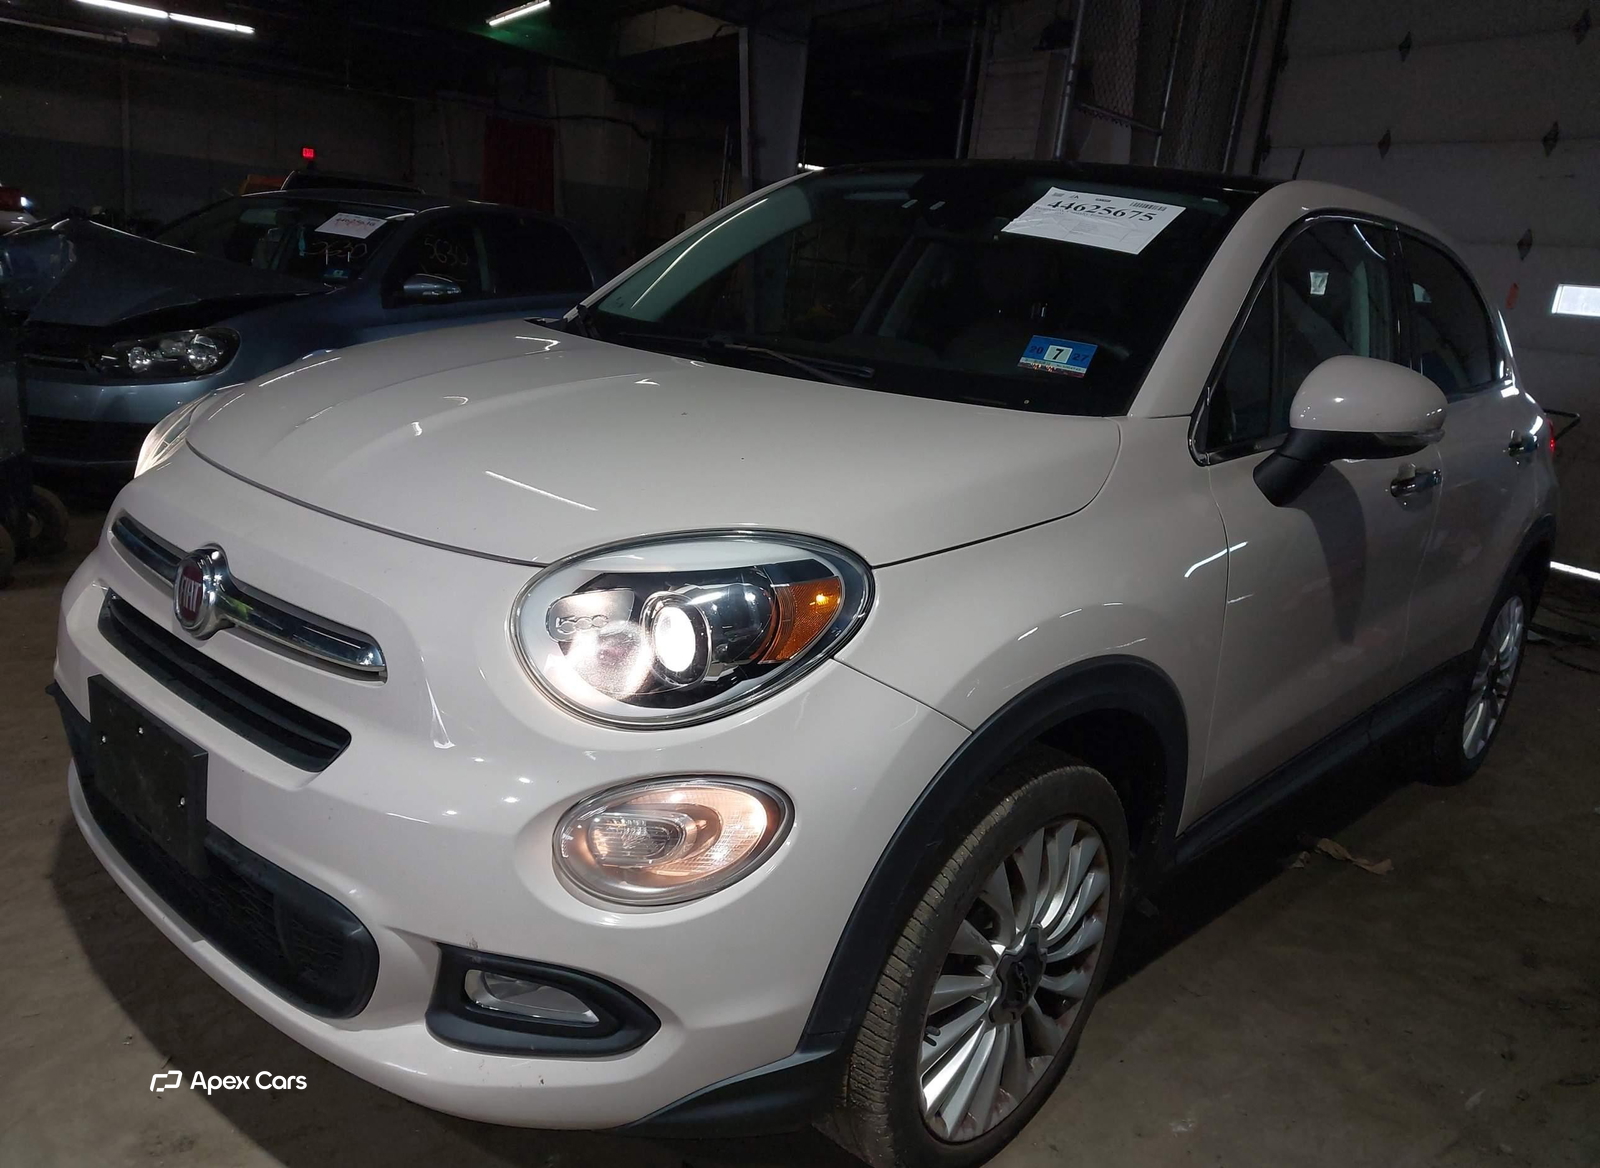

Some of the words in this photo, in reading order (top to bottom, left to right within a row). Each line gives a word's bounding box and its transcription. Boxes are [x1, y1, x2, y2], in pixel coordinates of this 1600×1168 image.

[1047, 201, 1158, 222] 44625675
[1052, 348, 1065, 360] 7
[180, 574, 202, 613] FIAT
